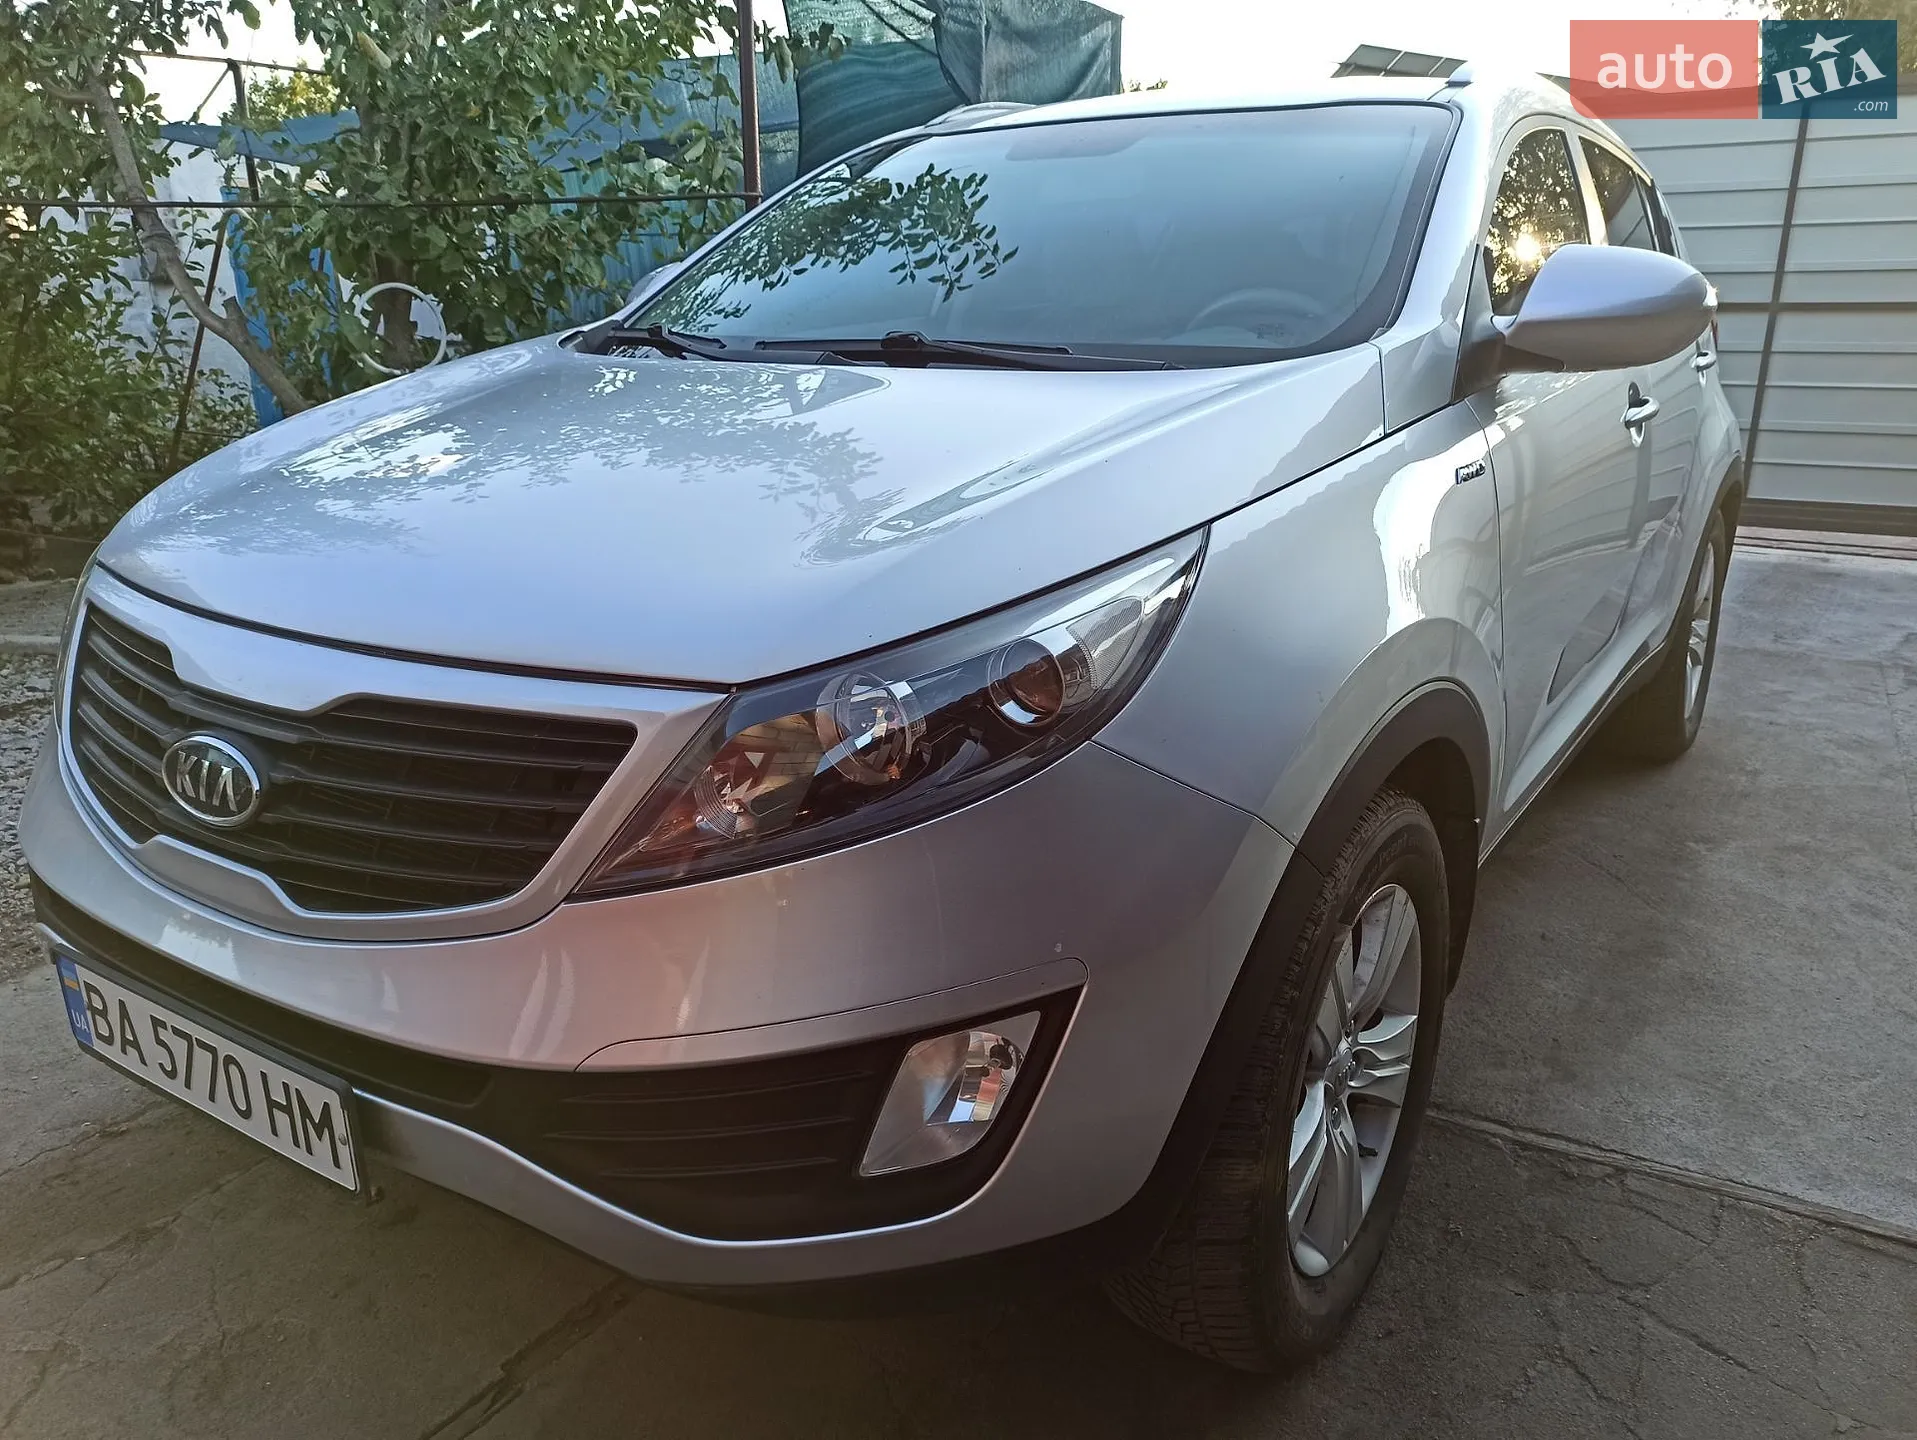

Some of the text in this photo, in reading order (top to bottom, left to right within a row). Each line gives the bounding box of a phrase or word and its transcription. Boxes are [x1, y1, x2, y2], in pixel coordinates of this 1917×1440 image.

[176, 750, 239, 813] KIA
[71, 1012, 90, 1034] UA
[82, 979, 342, 1170] BA 5770 HM
